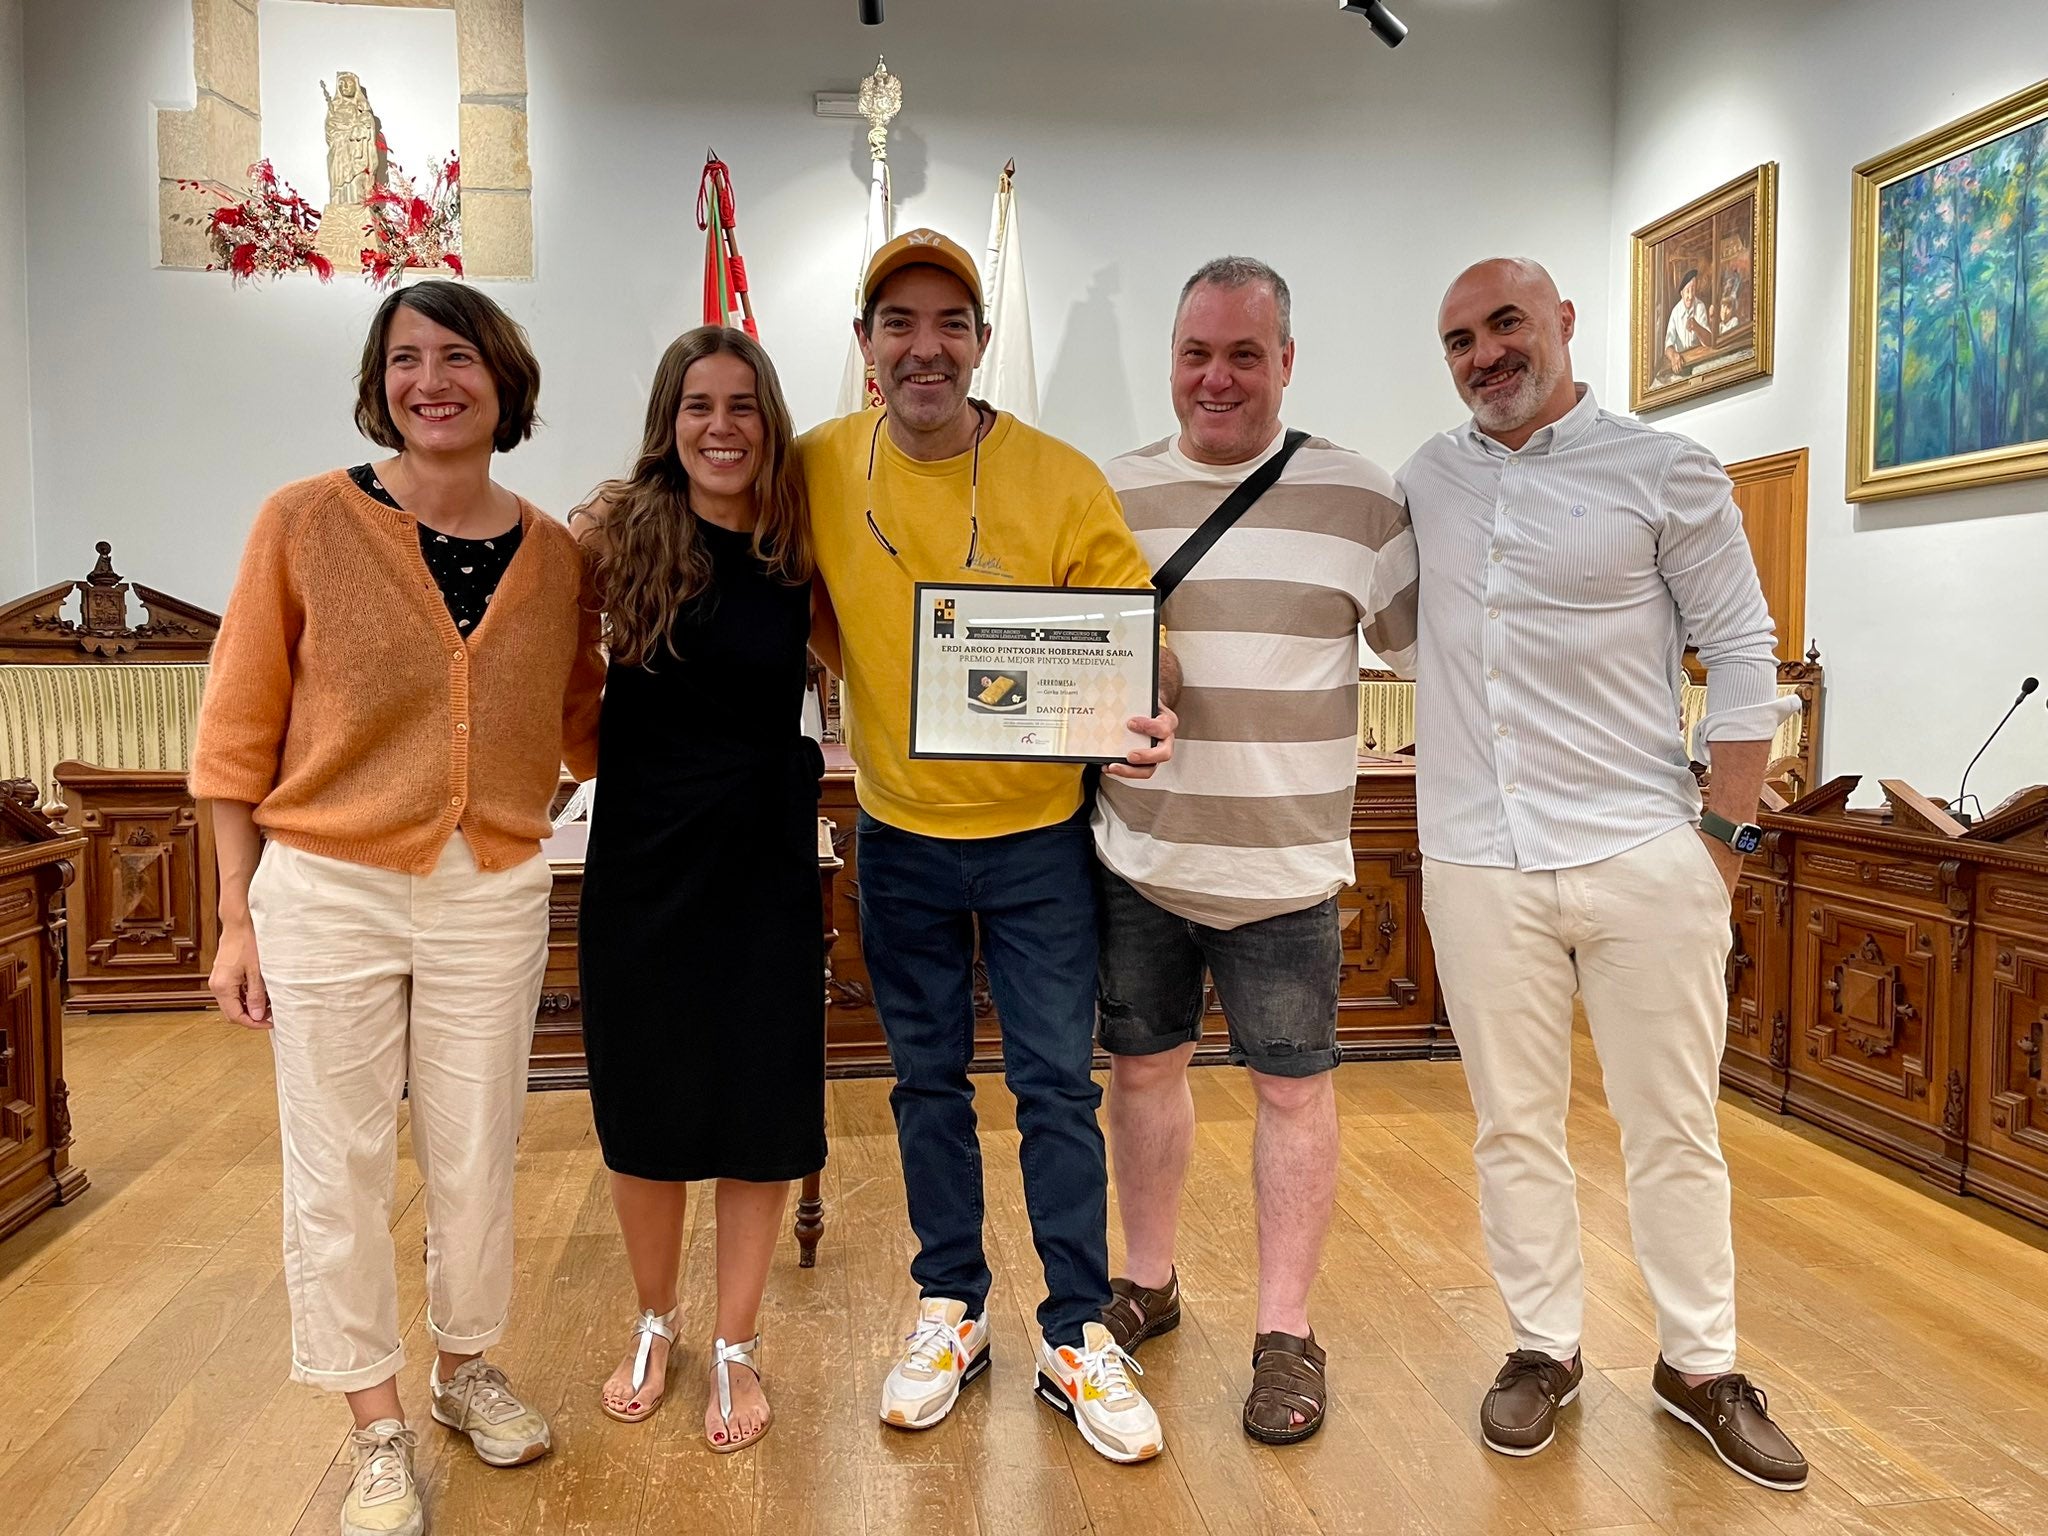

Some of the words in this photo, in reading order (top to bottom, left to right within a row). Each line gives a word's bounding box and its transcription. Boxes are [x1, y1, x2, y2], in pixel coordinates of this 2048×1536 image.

[941, 645, 962, 653] ERDI
[963, 646, 995, 654] AROKO
[997, 647, 1046, 655] PINTXORIK
[1048, 648, 1104, 656] HOBERENARI
[1106, 649, 1134, 657] SARIA
[959, 655, 992, 663] PREMIO
[993, 656, 1006, 664] AL
[1007, 656, 1035, 665] MEJOR
[1037, 657, 1070, 665] PINTXO
[1071, 658, 1116, 666] MEDIEVAL
[1036, 706, 1095, 714] DANONTZAT
